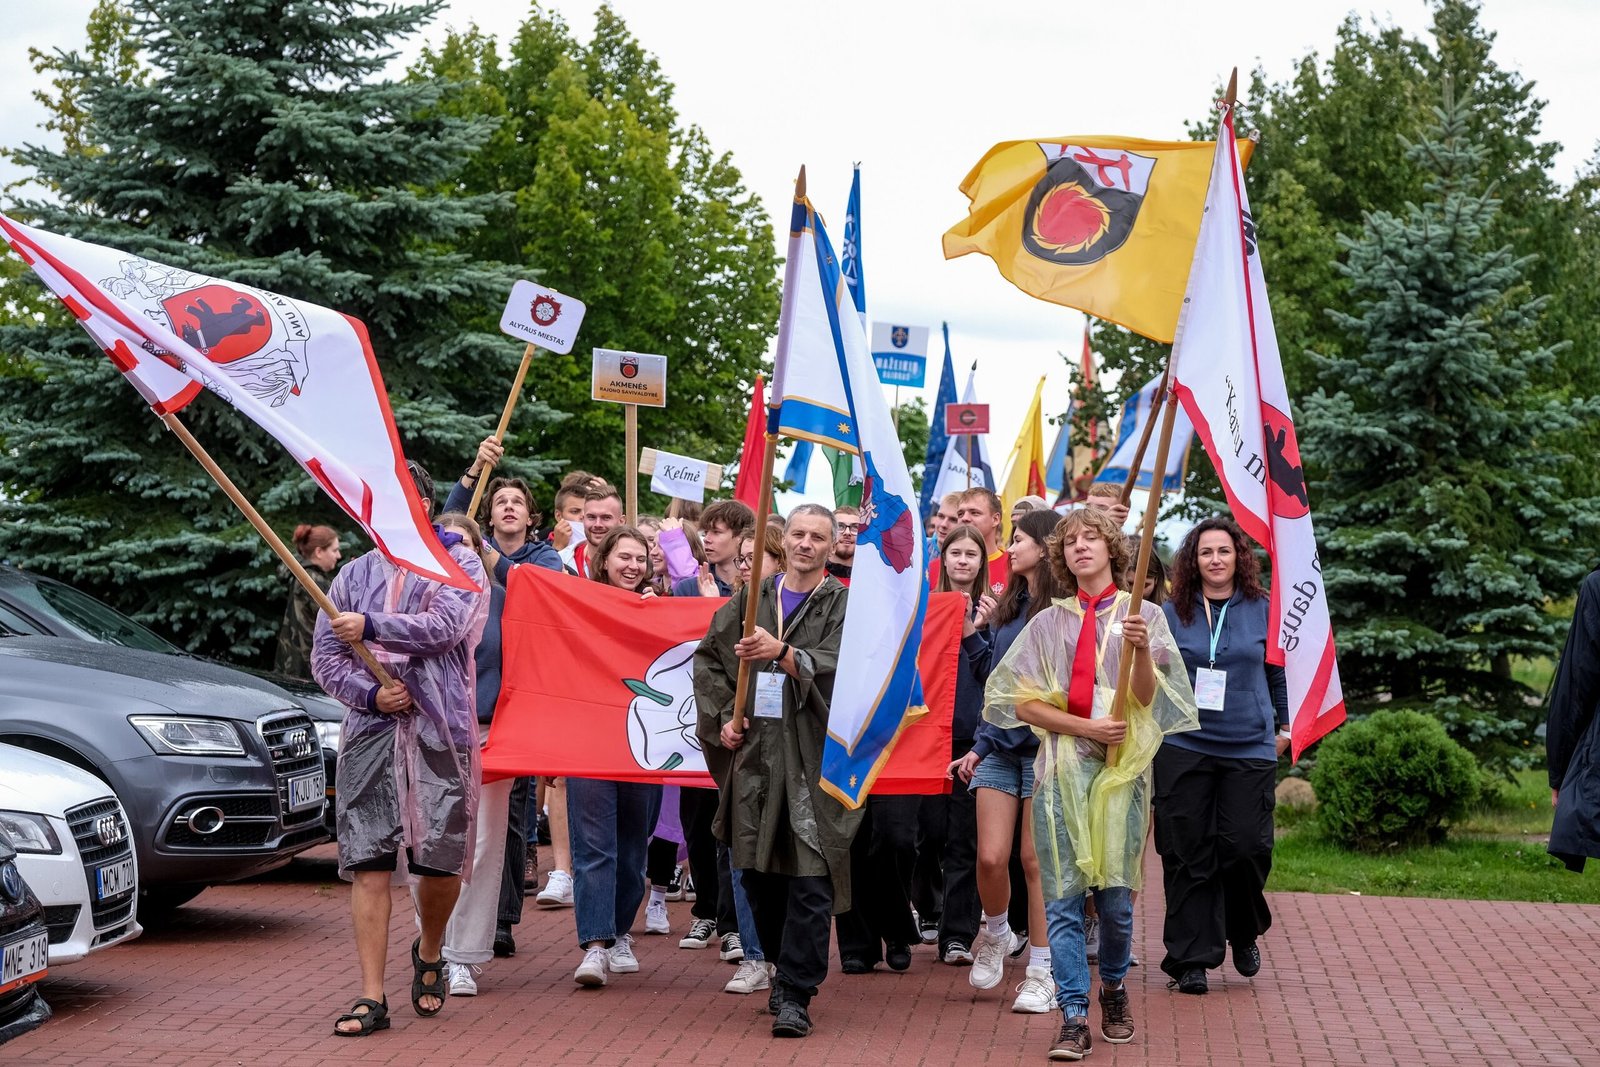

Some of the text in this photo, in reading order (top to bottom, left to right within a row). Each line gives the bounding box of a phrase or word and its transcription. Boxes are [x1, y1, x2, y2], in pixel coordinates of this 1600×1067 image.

[508, 320, 565, 346] ALYTAUS MIESTAS
[599, 386, 658, 398] RAJONO SAVIVALDYBĖ
[609, 380, 648, 391] AKMENĖS
[663, 464, 701, 482] Kelmė
[295, 779, 310, 804] KJU
[103, 866, 120, 895] MCM
[4, 937, 47, 980] MNE 319
